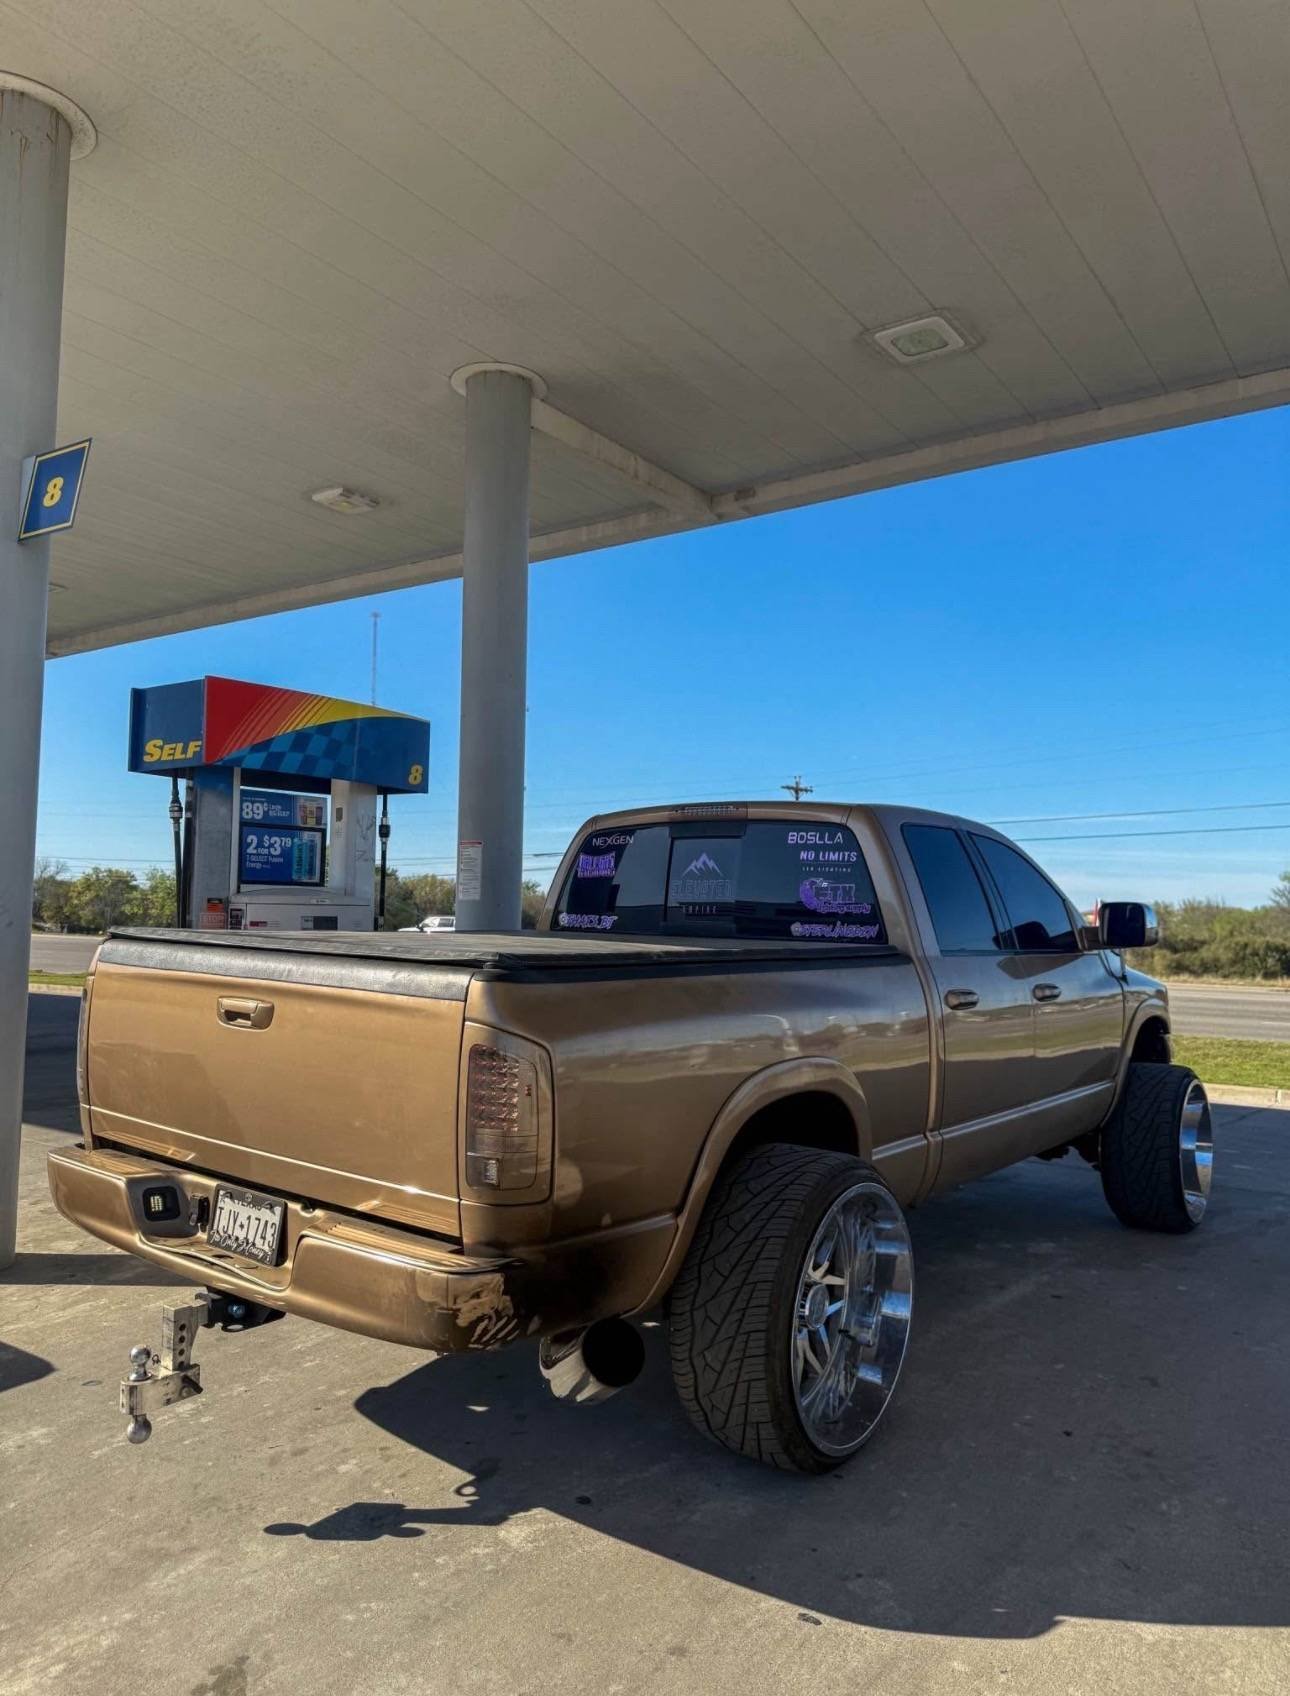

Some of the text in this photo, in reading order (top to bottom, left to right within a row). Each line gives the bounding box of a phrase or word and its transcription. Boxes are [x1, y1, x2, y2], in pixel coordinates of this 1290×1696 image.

[43, 476, 64, 508] 8
[143, 739, 202, 763] SELF
[408, 764, 424, 785] 8
[246, 834, 258, 855] 2
[592, 833, 634, 849] NEXGEN
[788, 831, 843, 845] BOSLLA
[800, 850, 857, 862] NO LIMITS
